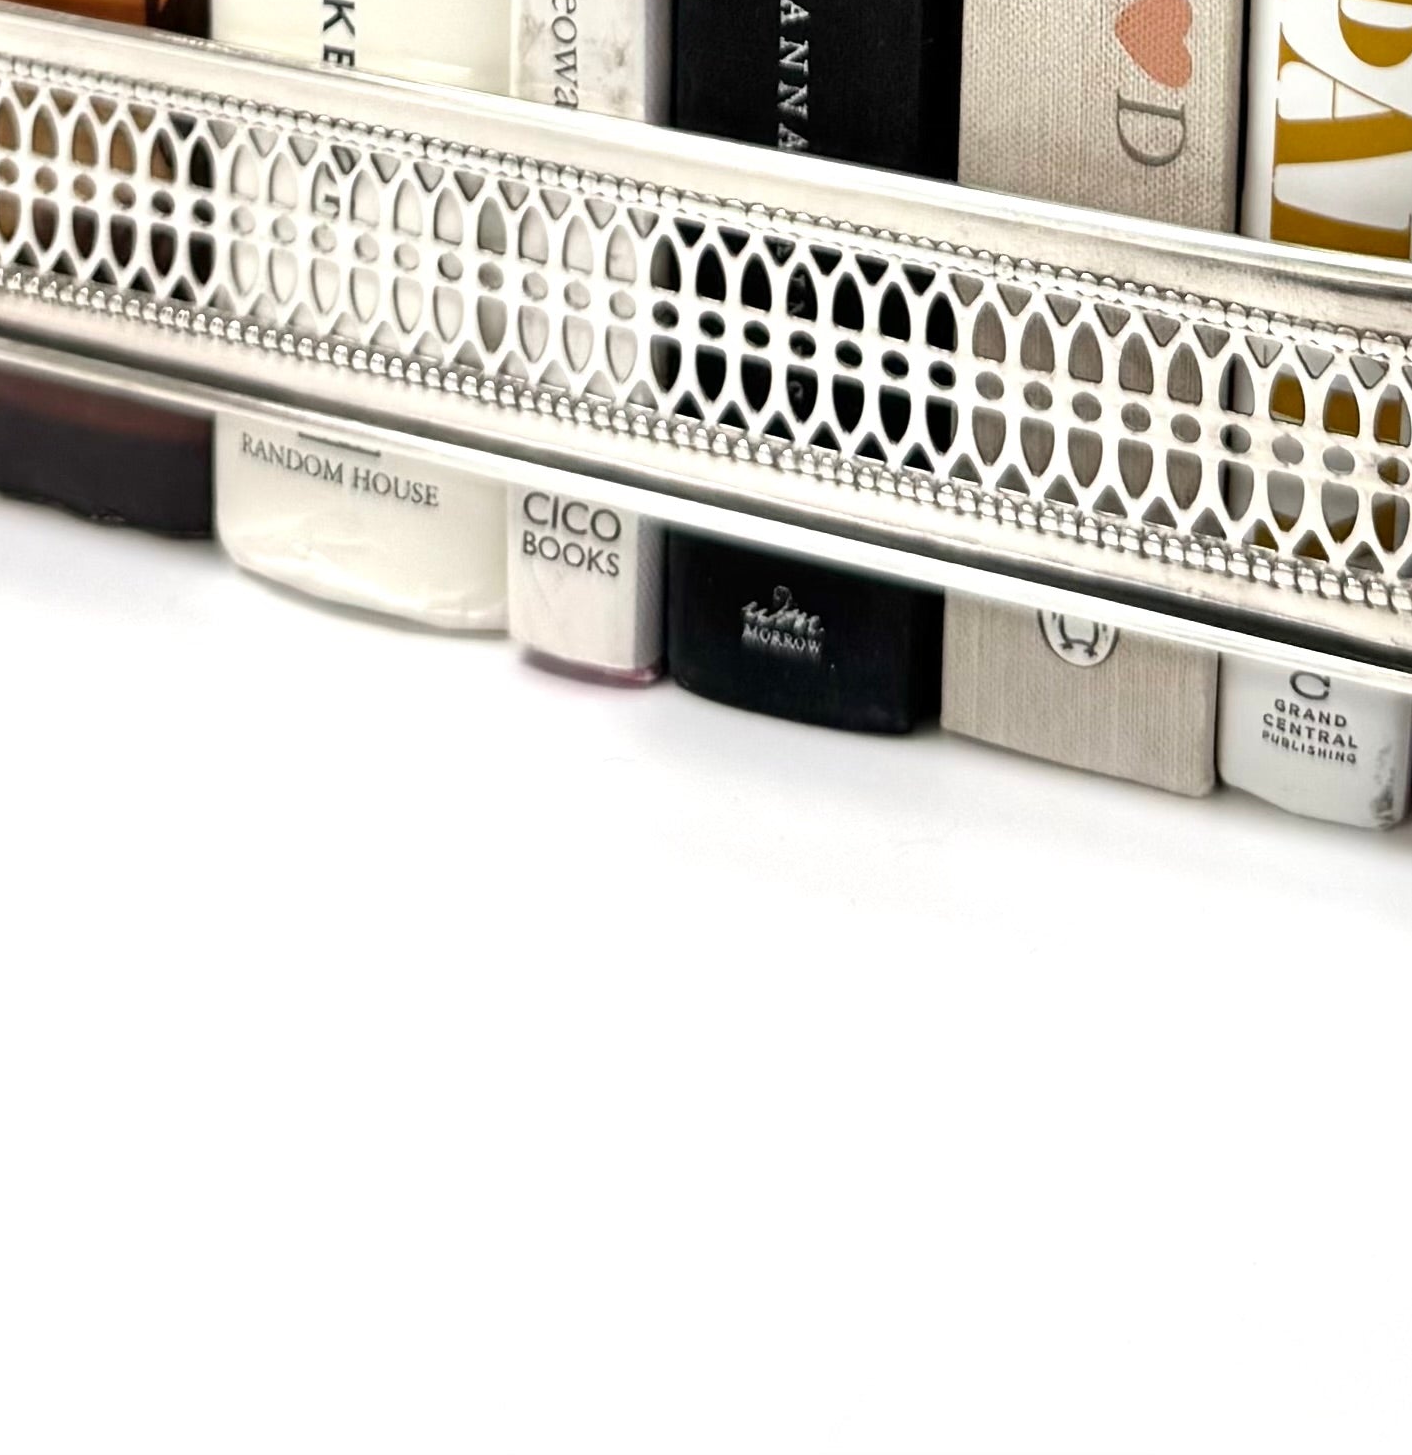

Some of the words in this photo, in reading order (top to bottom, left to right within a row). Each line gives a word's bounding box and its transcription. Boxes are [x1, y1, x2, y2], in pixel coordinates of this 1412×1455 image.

[241, 431, 345, 484] RANDOM
[352, 468, 441, 508] HOUSE
[522, 490, 623, 543] CICO
[522, 532, 622, 579] BOOKS
[741, 623, 822, 654] MORROW
[1262, 712, 1359, 750] CENTRAL
[1274, 697, 1348, 728] GRAND
[1261, 729, 1358, 765] PUBLISHING
